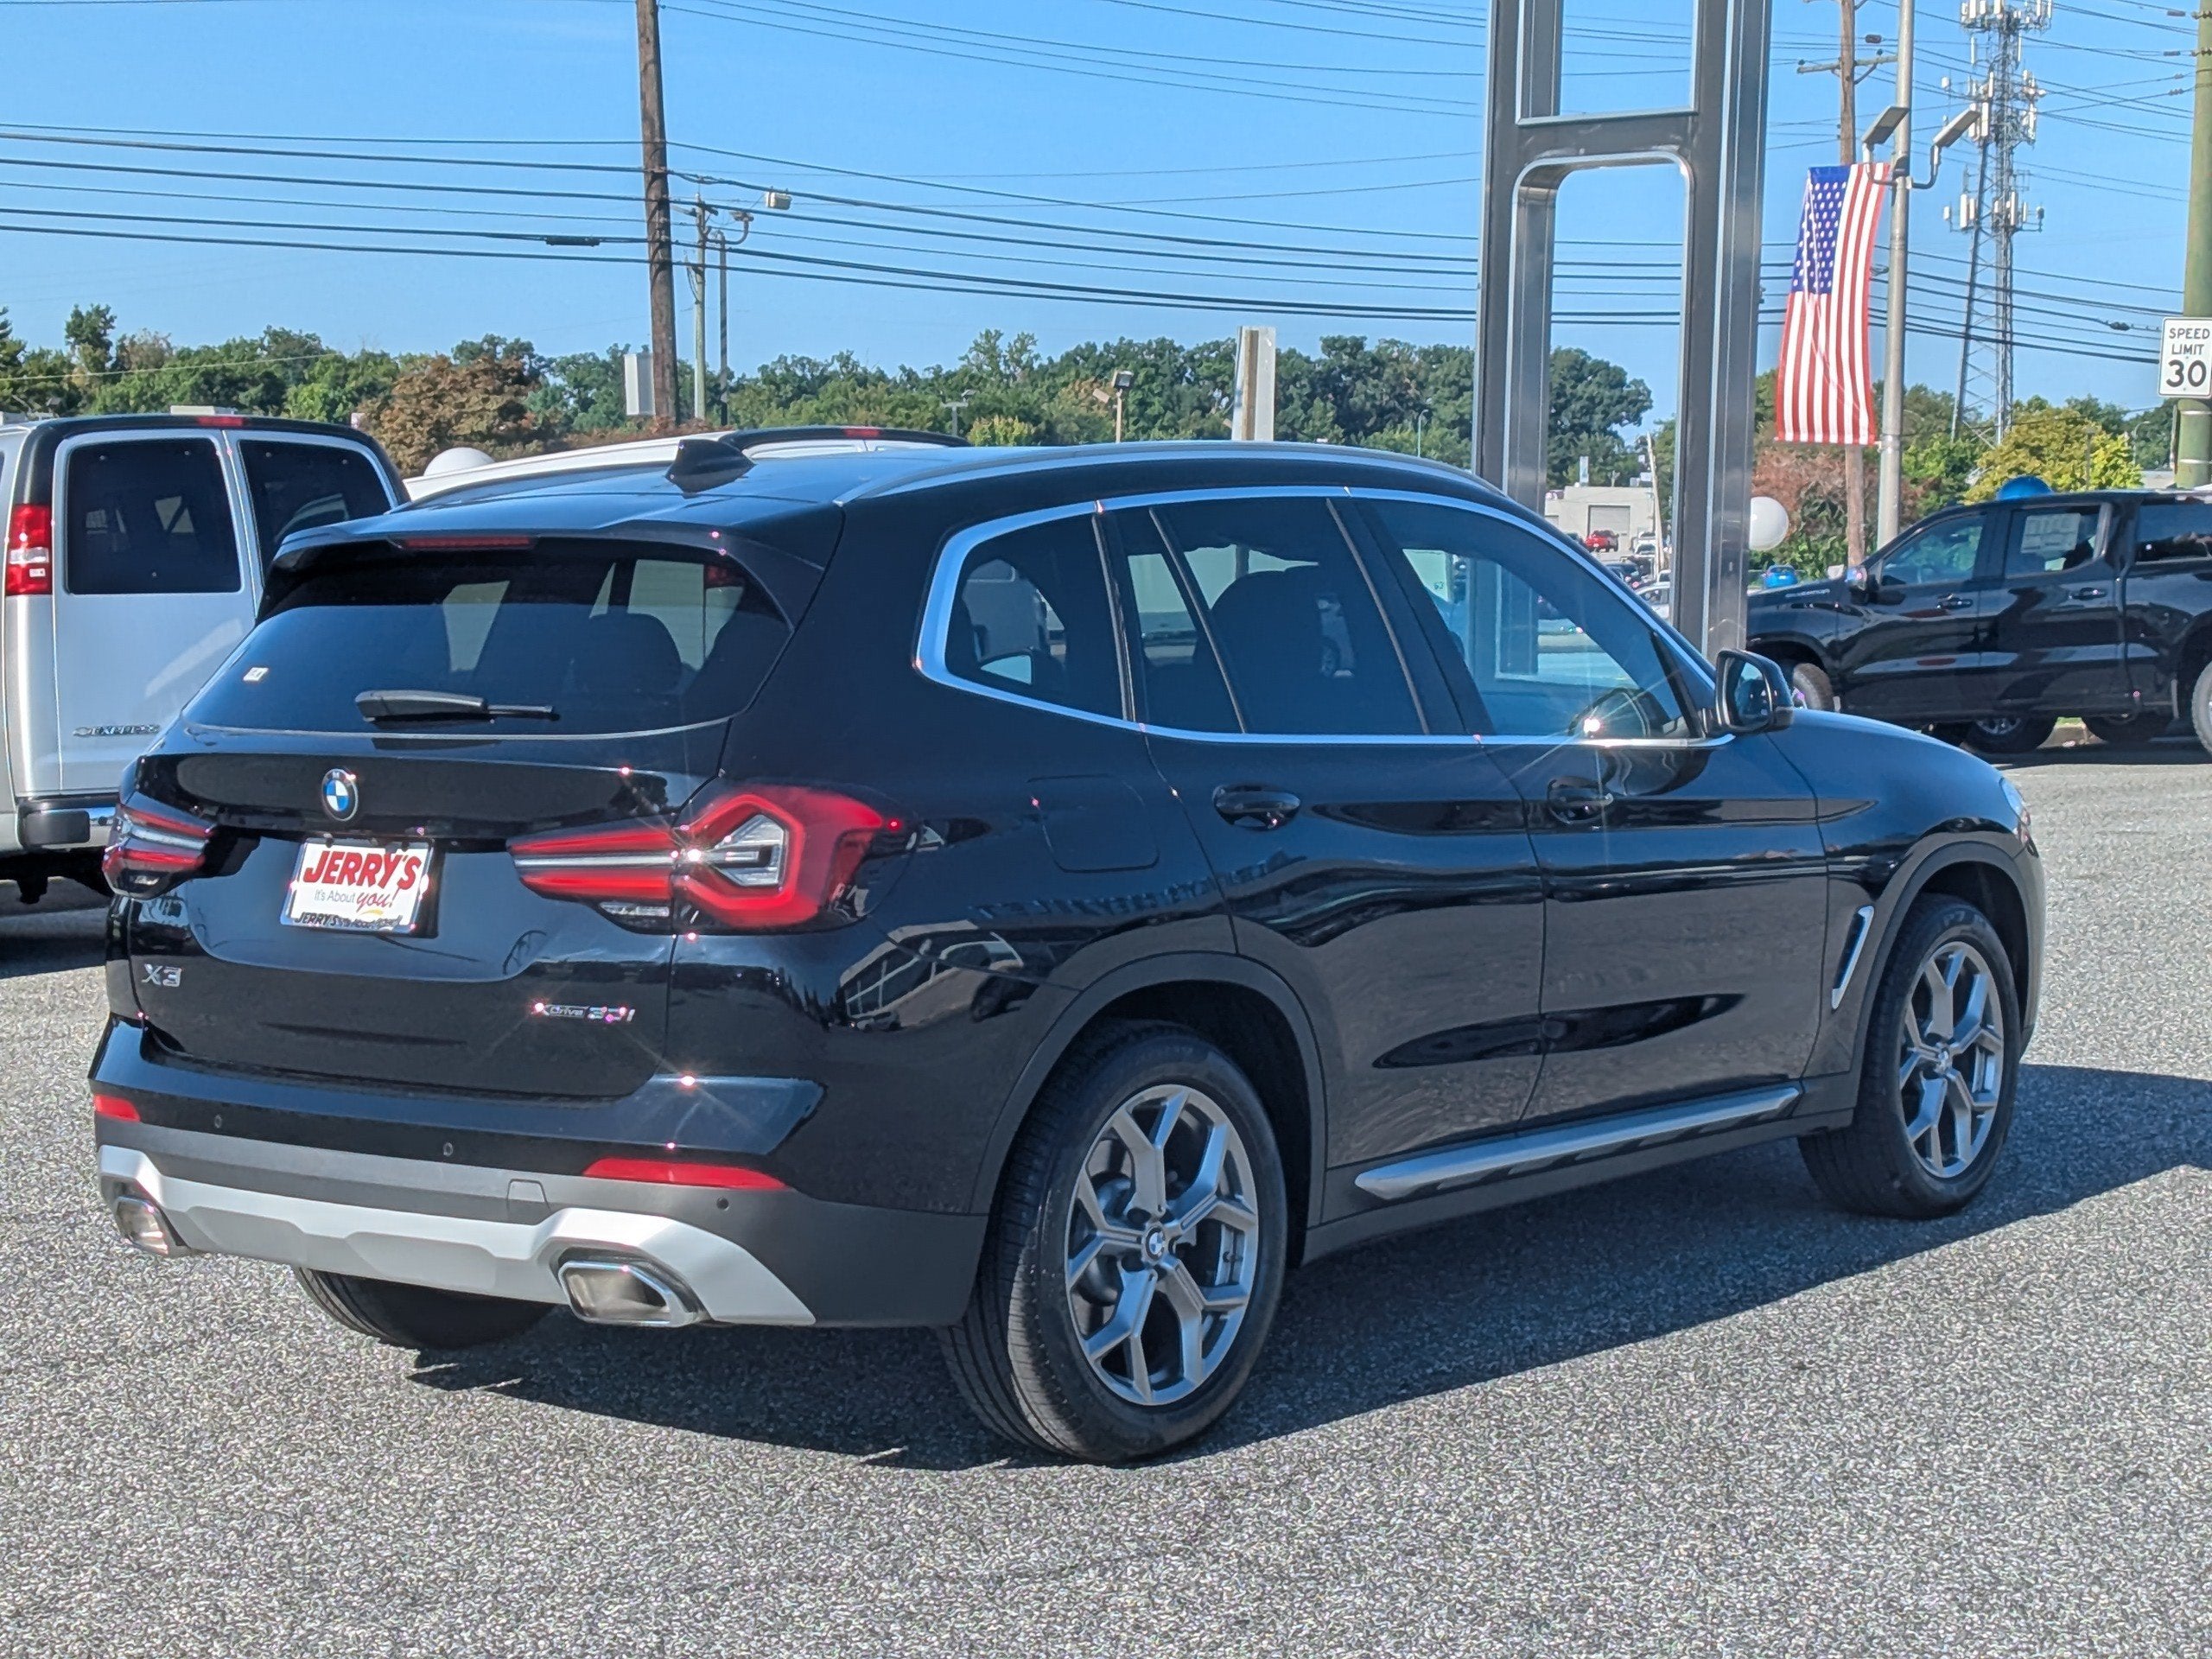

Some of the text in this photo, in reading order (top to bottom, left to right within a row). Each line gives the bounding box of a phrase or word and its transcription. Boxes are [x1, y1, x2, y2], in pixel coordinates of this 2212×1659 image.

[2169, 327, 2210, 340] SPEED
[2171, 344, 2204, 355] LIMIT
[2166, 359, 2206, 387] 30
[302, 850, 422, 890] JERRY'S
[314, 887, 401, 912] It's About you!
[141, 963, 182, 987] X3
